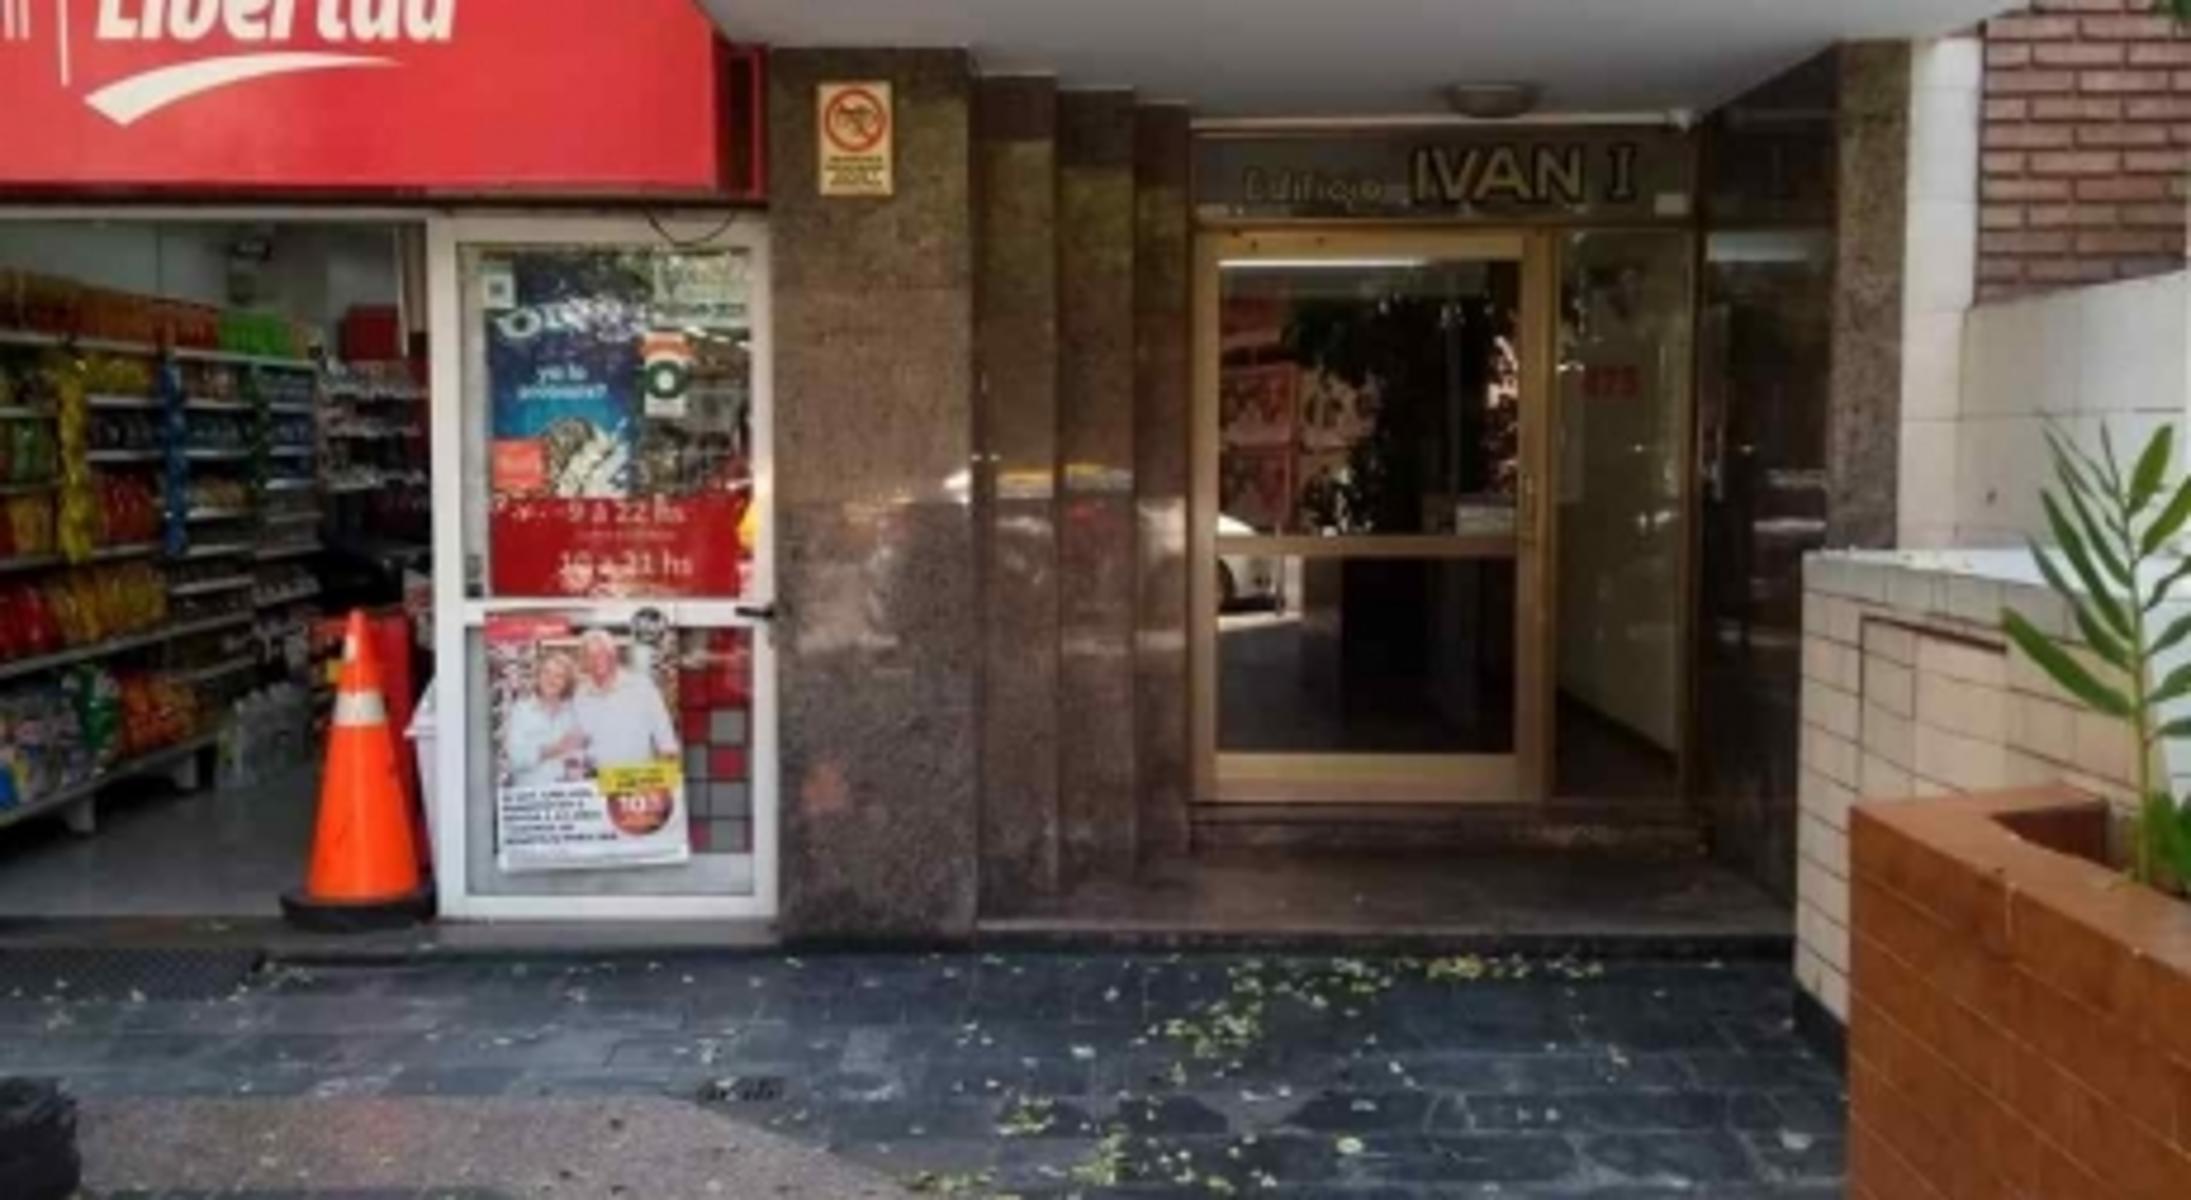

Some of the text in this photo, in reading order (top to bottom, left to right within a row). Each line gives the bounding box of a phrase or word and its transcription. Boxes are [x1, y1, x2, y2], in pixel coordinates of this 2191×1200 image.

[1409, 144, 1586, 204] IVAN
[1608, 144, 1637, 200] I
[615, 501, 649, 523] 22
[662, 550, 694, 576] hs
